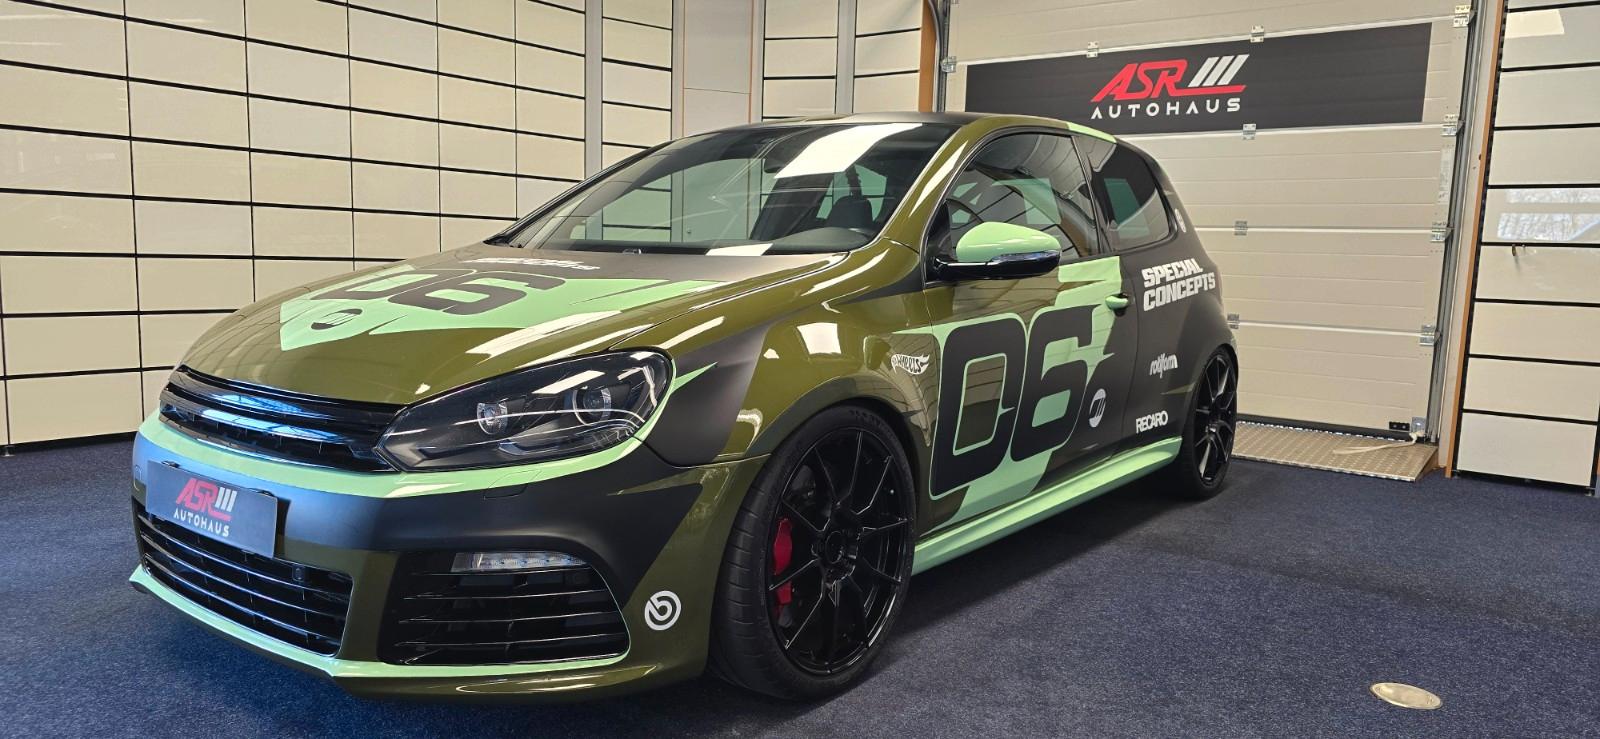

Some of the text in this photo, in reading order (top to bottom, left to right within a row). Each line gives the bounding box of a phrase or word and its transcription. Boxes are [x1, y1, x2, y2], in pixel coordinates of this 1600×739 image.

[1091, 58, 1246, 102] ASR
[1090, 97, 1241, 120] AUTOHAUS
[1141, 258, 1204, 288] SPECIAL
[1143, 271, 1216, 311] CONCEPTS
[930, 303, 1102, 500] 06
[1135, 410, 1169, 434] RECARO
[175, 477, 232, 522] ASR
[173, 507, 230, 538] AUTOHAUS
